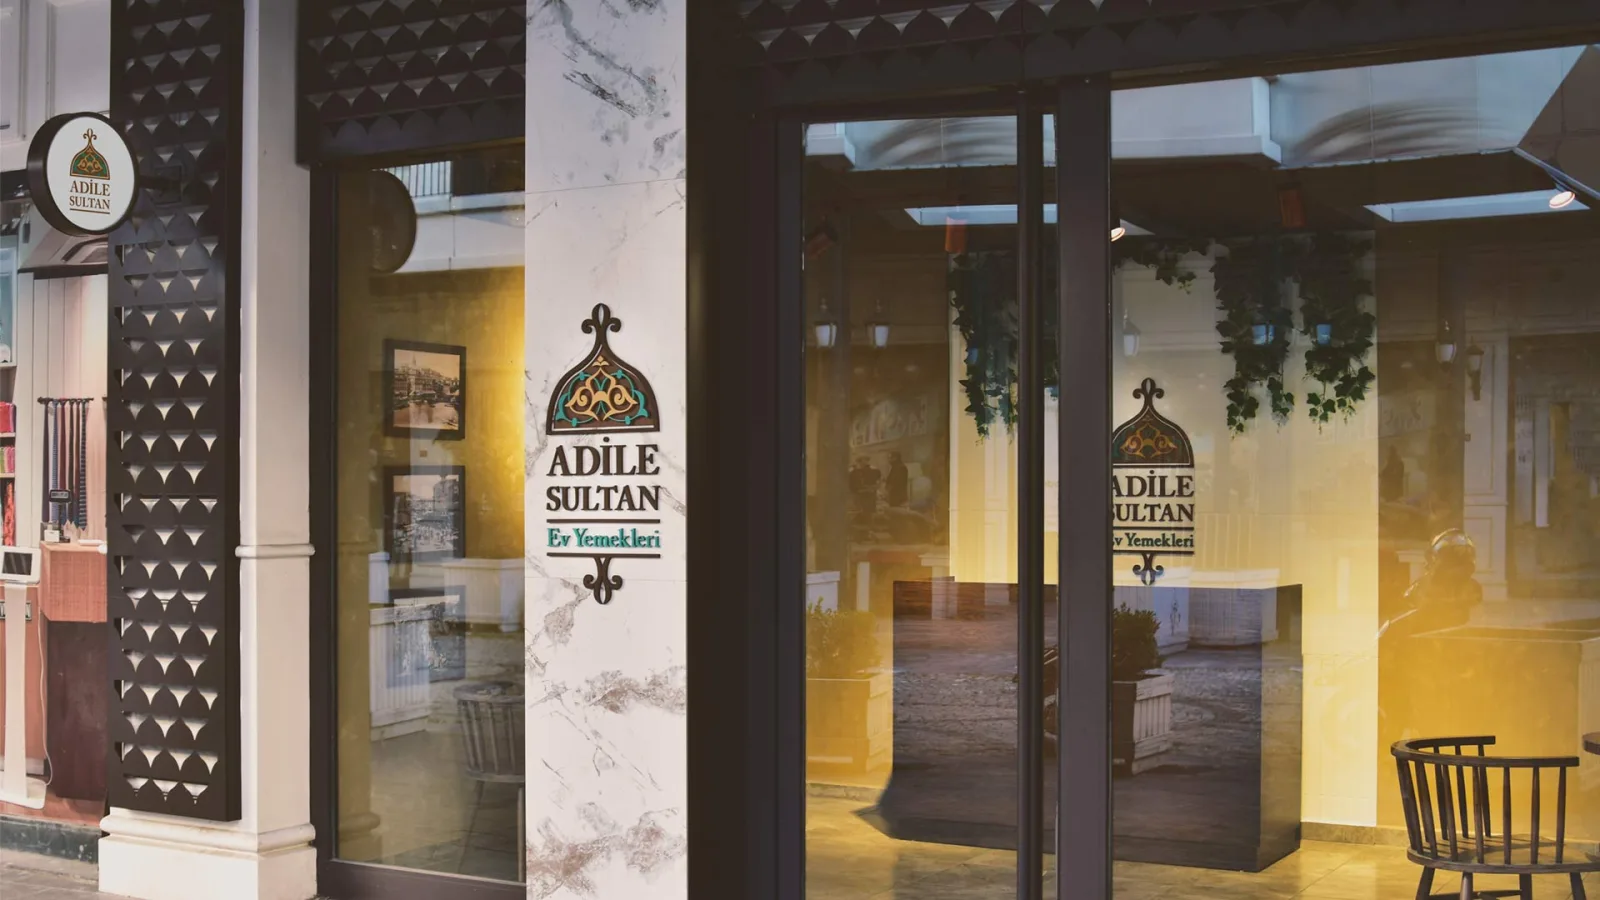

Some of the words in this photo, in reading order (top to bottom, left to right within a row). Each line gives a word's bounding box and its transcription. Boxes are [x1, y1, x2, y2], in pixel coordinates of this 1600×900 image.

[69, 179, 110, 196] ADİLE
[69, 195, 110, 209] SULTAN
[546, 436, 660, 476] ADİLE
[546, 485, 660, 511] SULTAN
[1112, 503, 1194, 522] ULTAN
[547, 528, 571, 547] Ev
[572, 528, 660, 548] Yemekleri
[1124, 532, 1194, 548] Yemekleri
